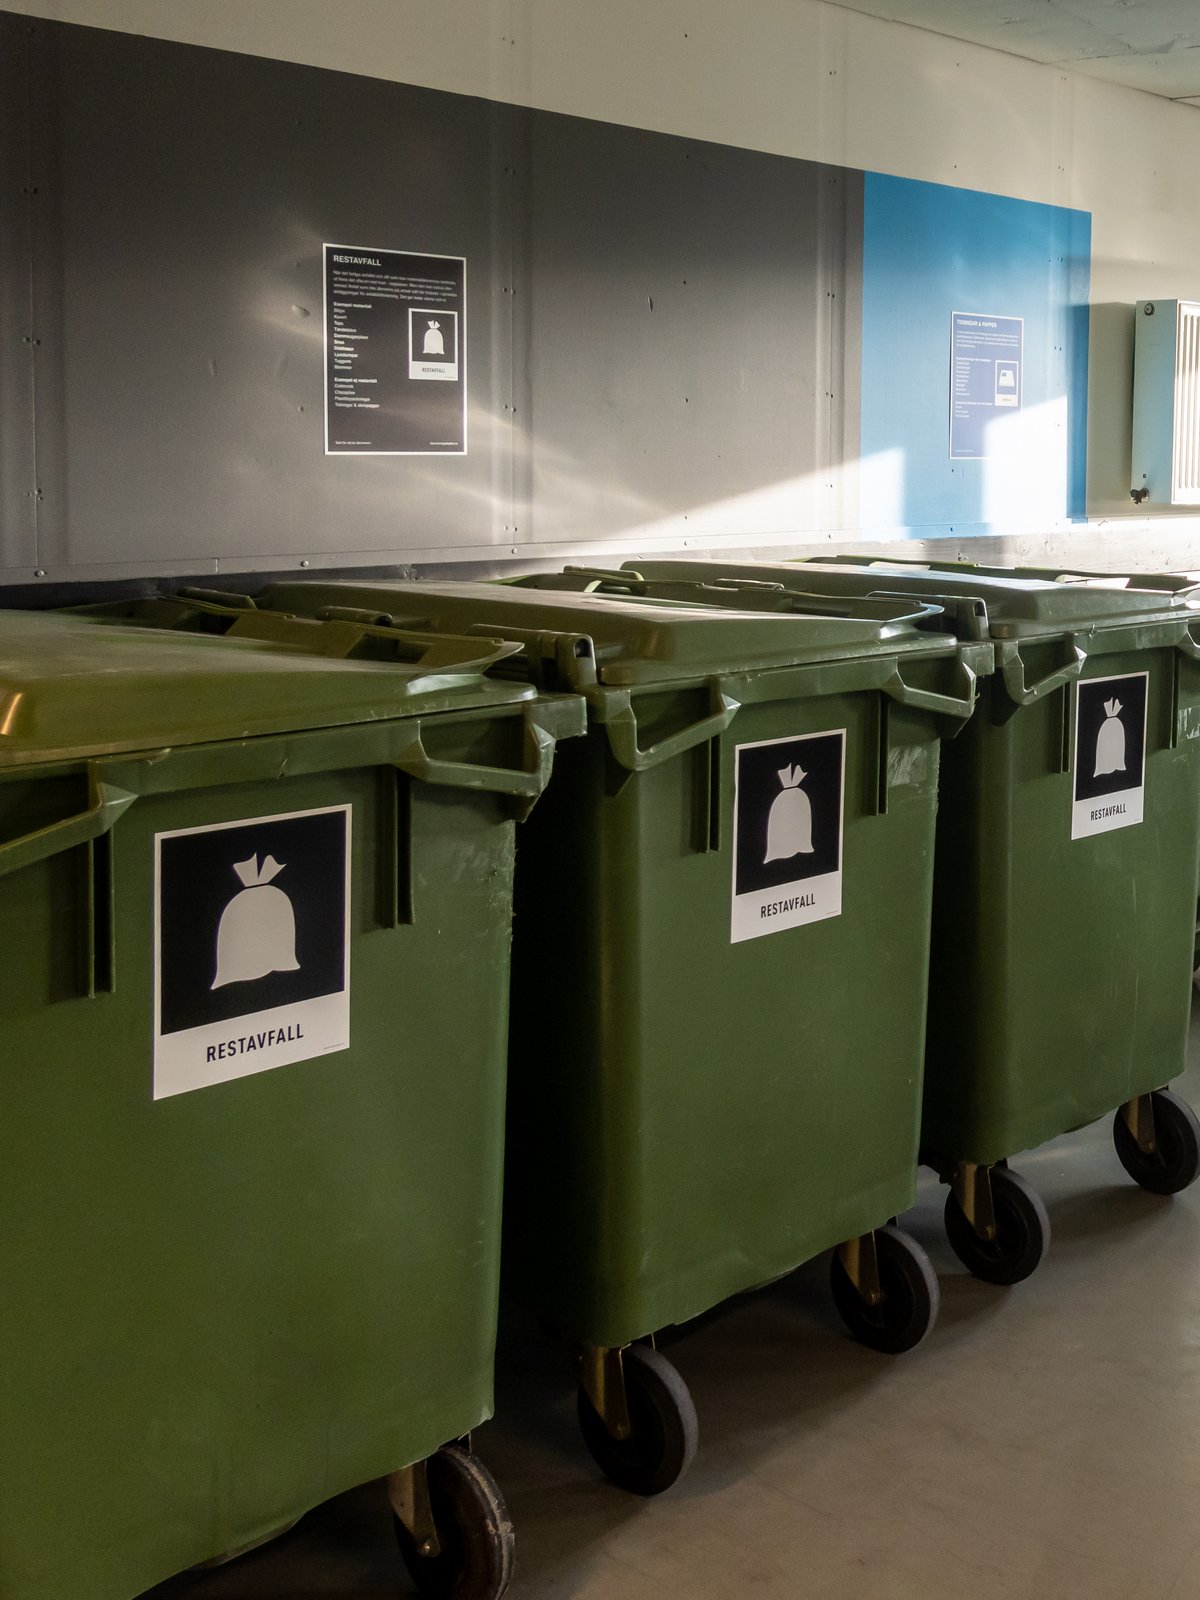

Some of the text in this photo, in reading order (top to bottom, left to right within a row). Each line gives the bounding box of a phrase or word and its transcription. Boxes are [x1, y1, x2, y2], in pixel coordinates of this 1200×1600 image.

[333, 254, 382, 266] RESTAVFALL
[1091, 803, 1126, 821] RESTAVFALL
[760, 893, 816, 918] RESTAVFALL
[207, 1023, 304, 1063] RESTAVFALL
